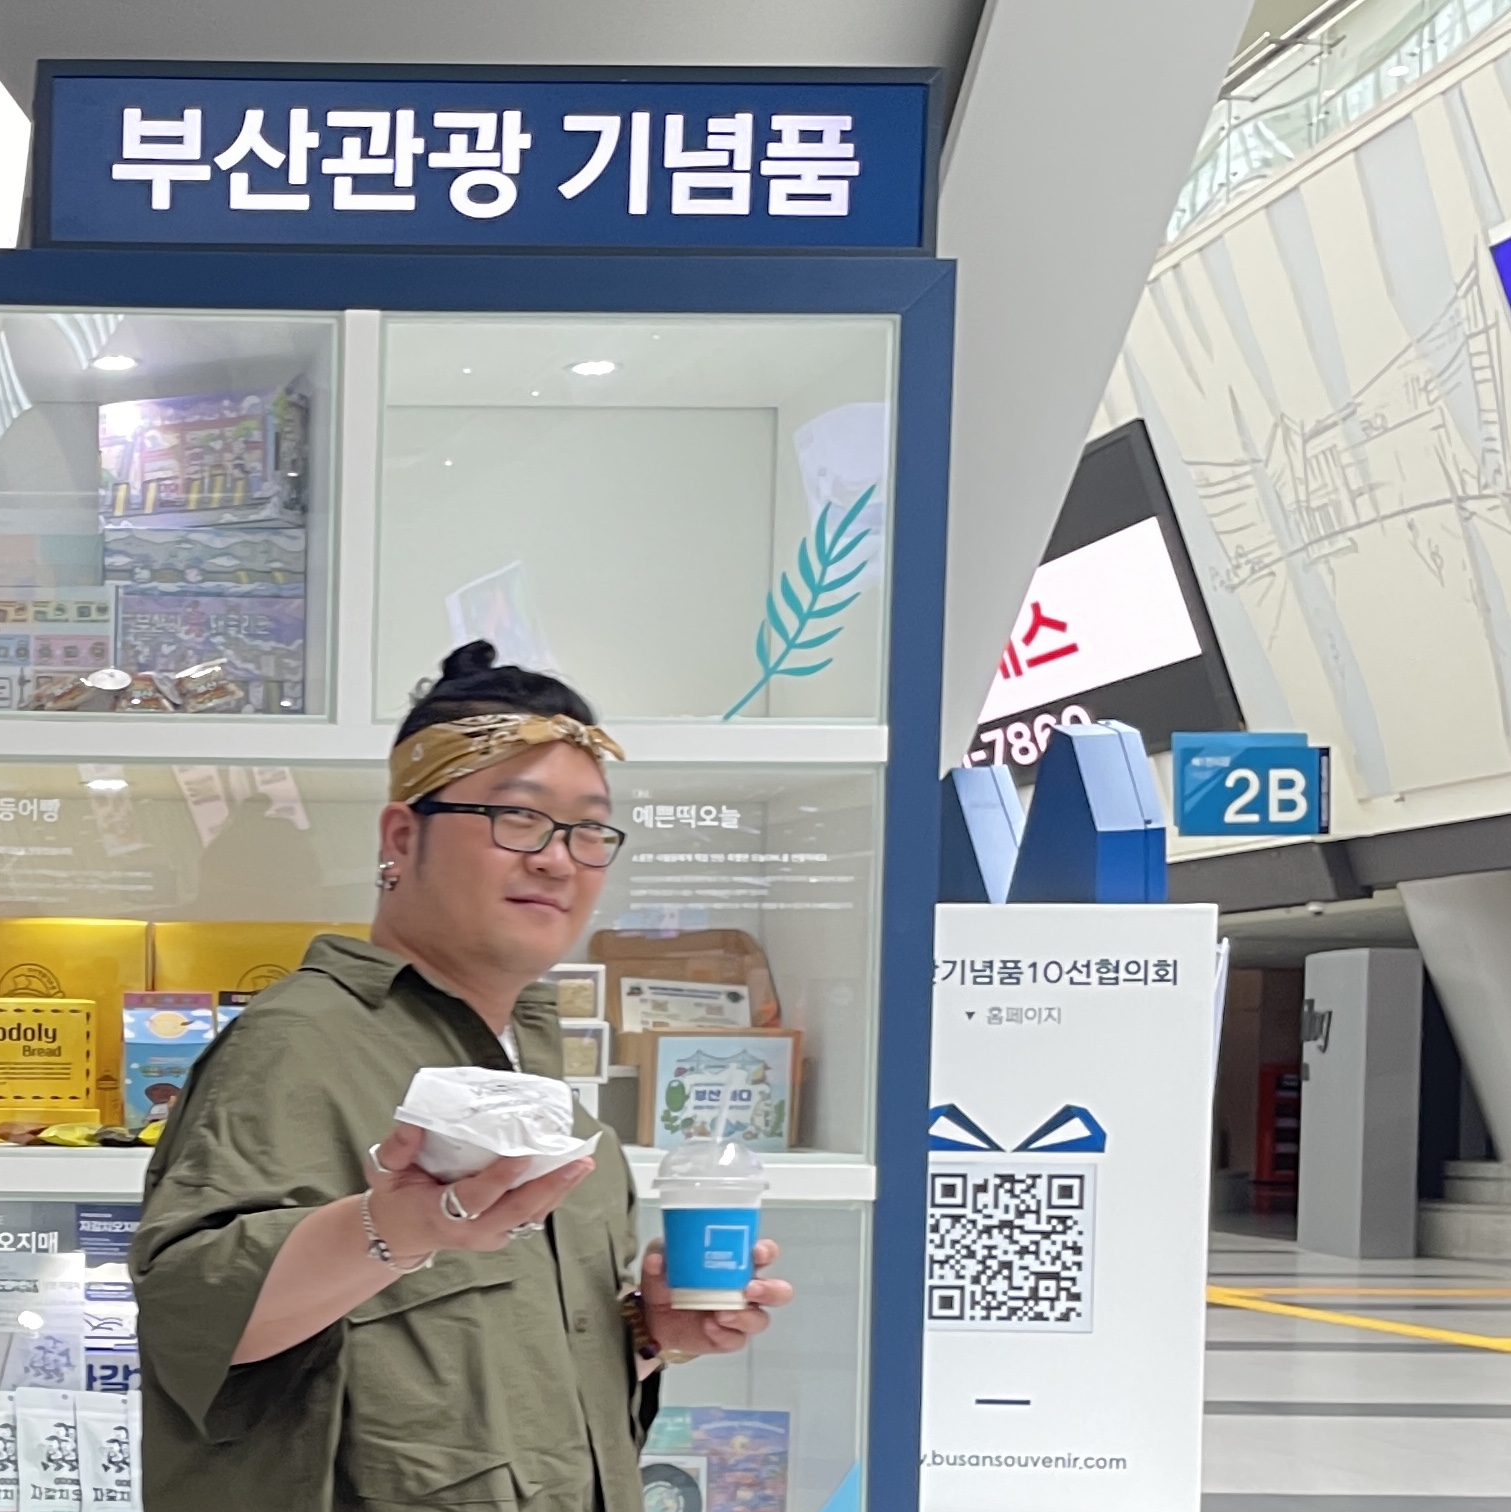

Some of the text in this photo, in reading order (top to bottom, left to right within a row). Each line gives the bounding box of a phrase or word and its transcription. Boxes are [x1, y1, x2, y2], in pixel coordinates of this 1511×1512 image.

[111, 108, 860, 219] 부산관광 기념품
[1222, 767, 1308, 824] 2B
[632, 804, 741, 829] 예쁜떡오늘
[932, 958, 1179, 986] 기념품10선협의회
[987, 1006, 1062, 1025] 홈페이지
[22, 1045, 62, 1057] Bread
